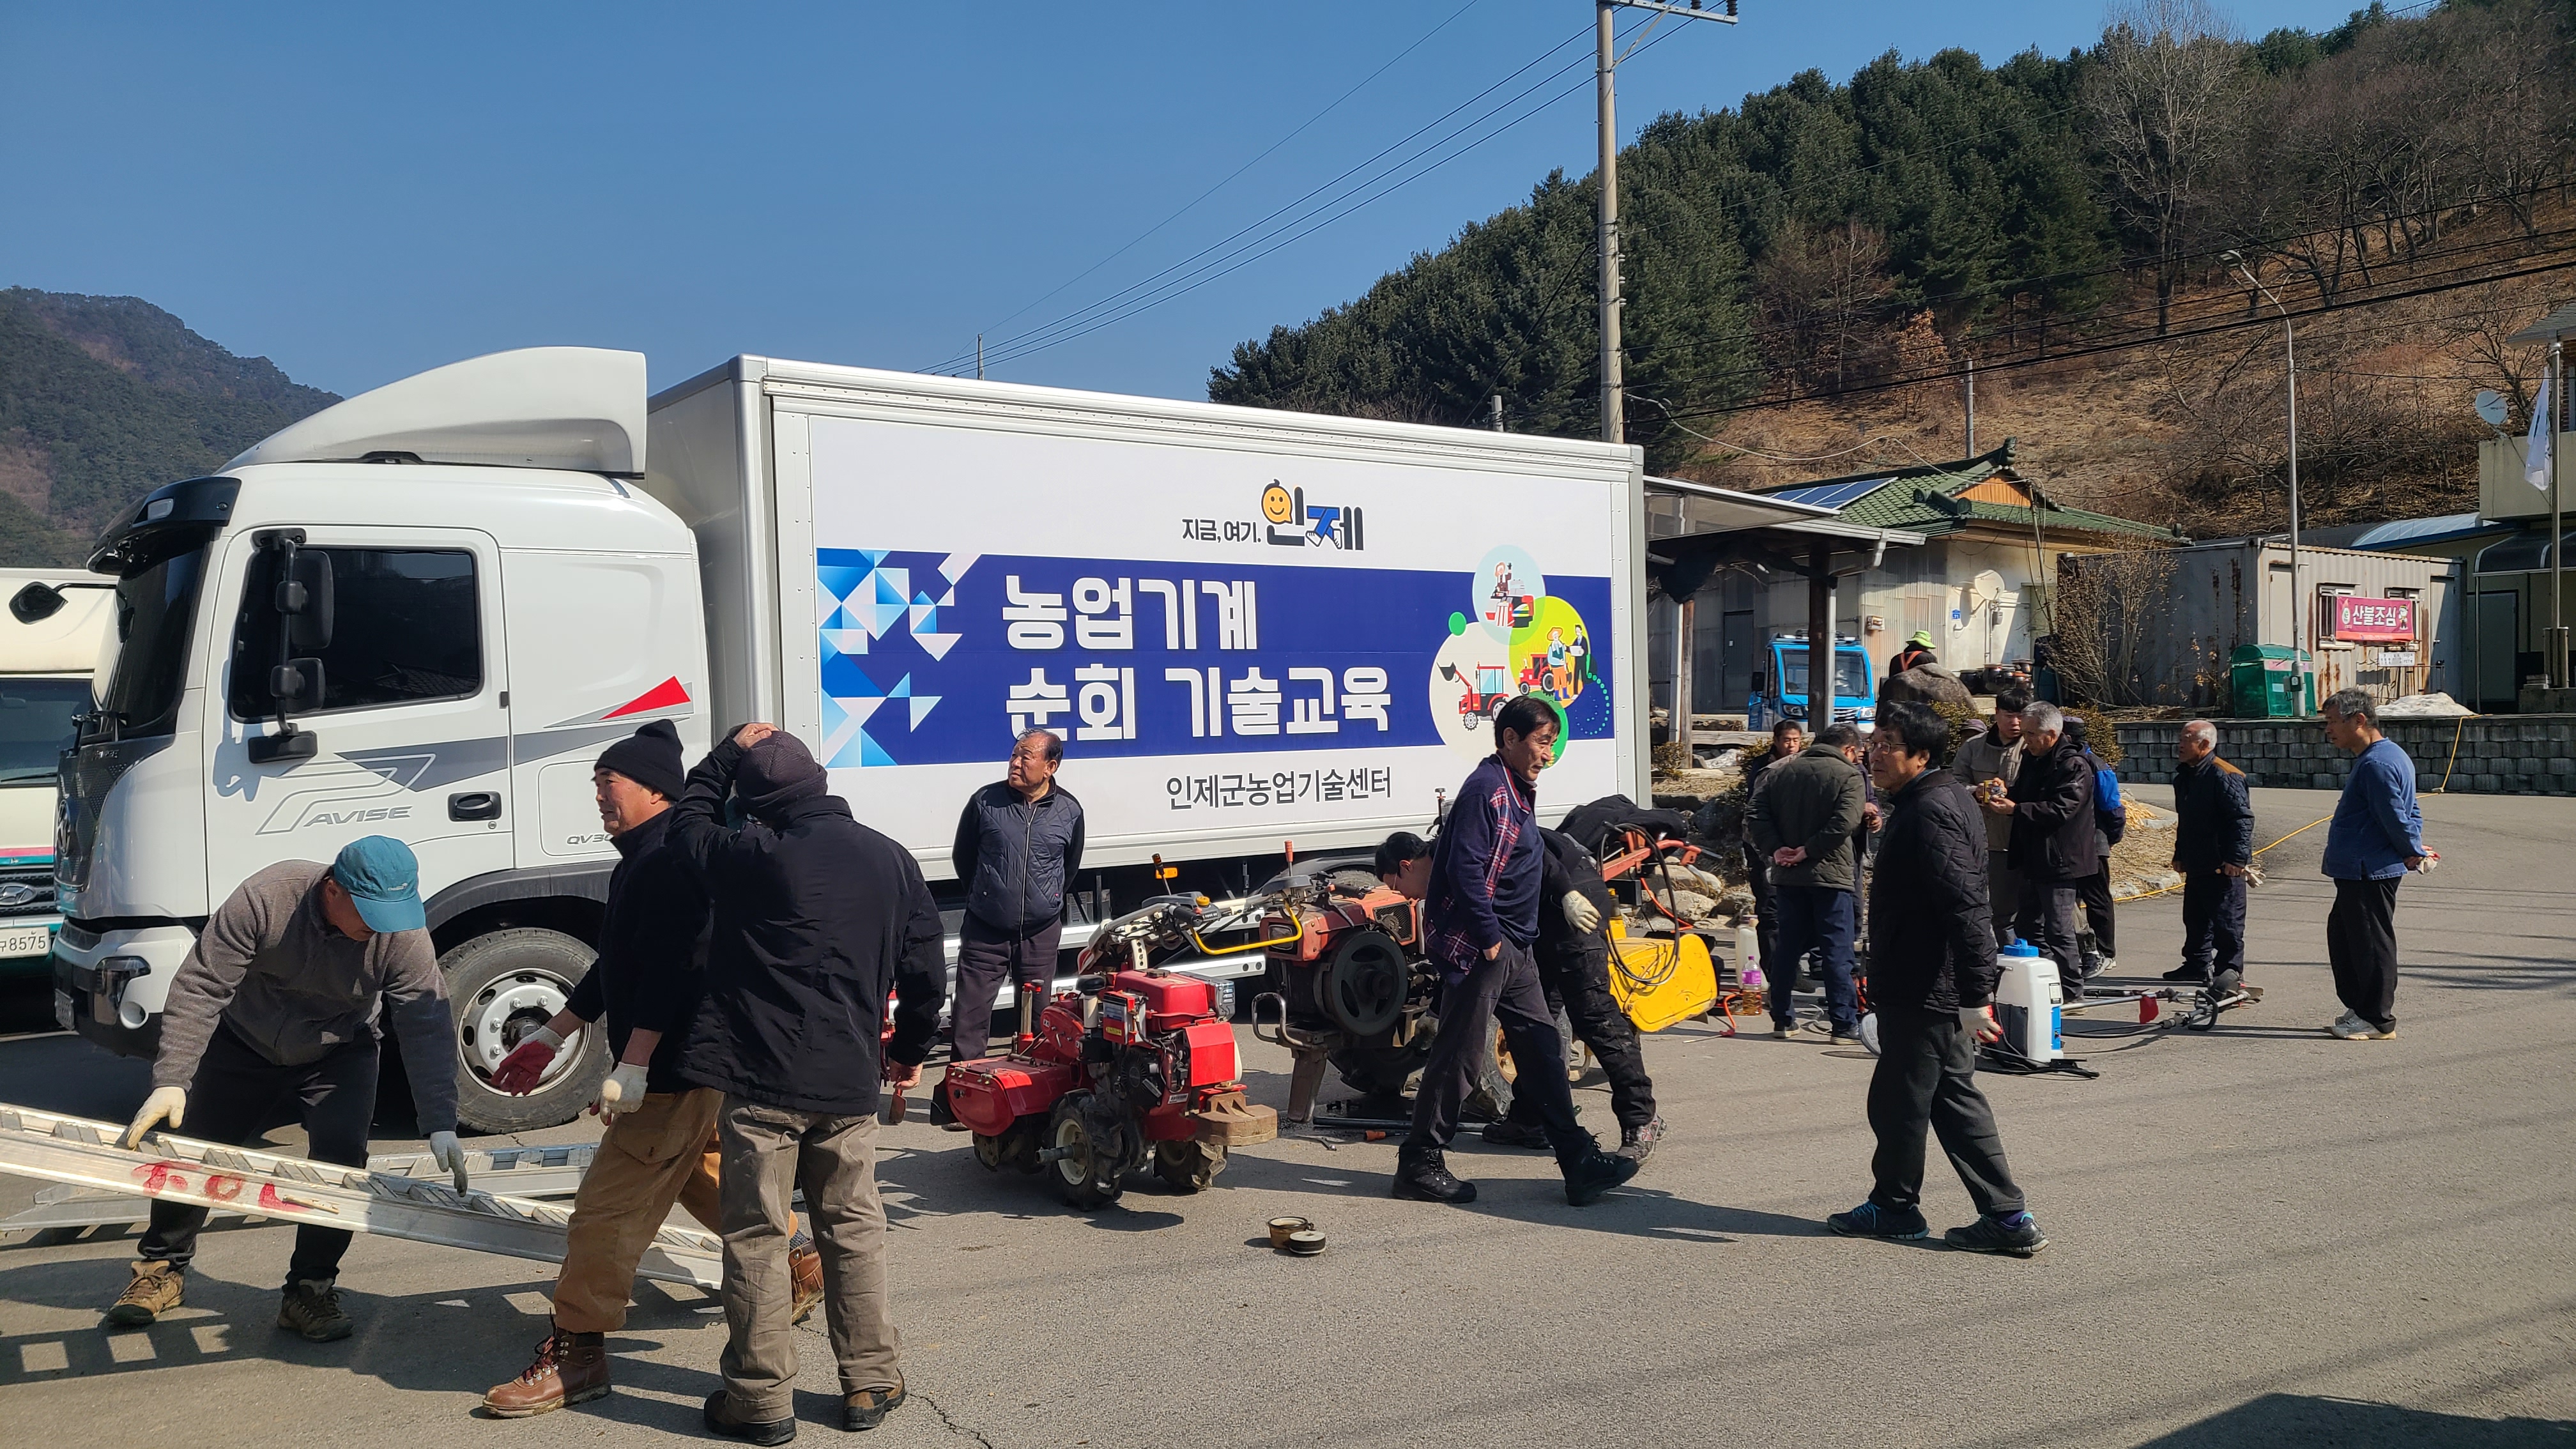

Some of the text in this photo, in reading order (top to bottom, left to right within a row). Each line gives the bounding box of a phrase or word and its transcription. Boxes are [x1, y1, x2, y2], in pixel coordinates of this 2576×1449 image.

[1182, 518, 1261, 543] 지금, 여기.
[1261, 479, 1365, 551] 인제
[1002, 575, 1257, 650] 농업기계
[2352, 605, 2396, 627] 산불조심
[1006, 663, 1391, 741] 순회 기술교육
[1167, 766, 1392, 810] 인제군농업기술센터
